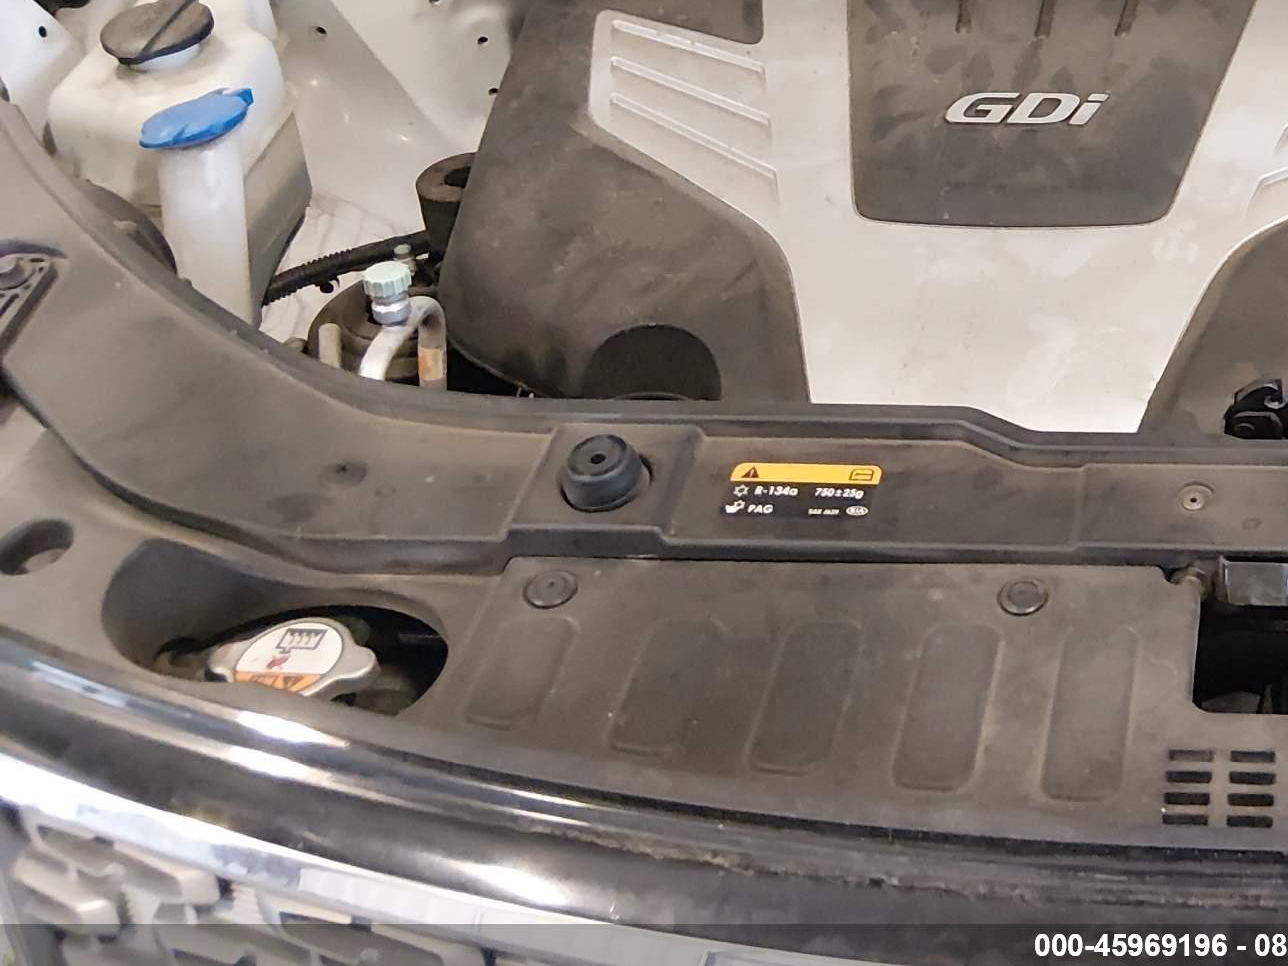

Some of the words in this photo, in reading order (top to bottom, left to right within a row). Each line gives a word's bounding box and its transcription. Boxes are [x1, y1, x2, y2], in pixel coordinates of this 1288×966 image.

[945, 92, 1111, 126] GDi
[754, 485, 799, 497] R-134a
[747, 504, 774, 514] PAG
